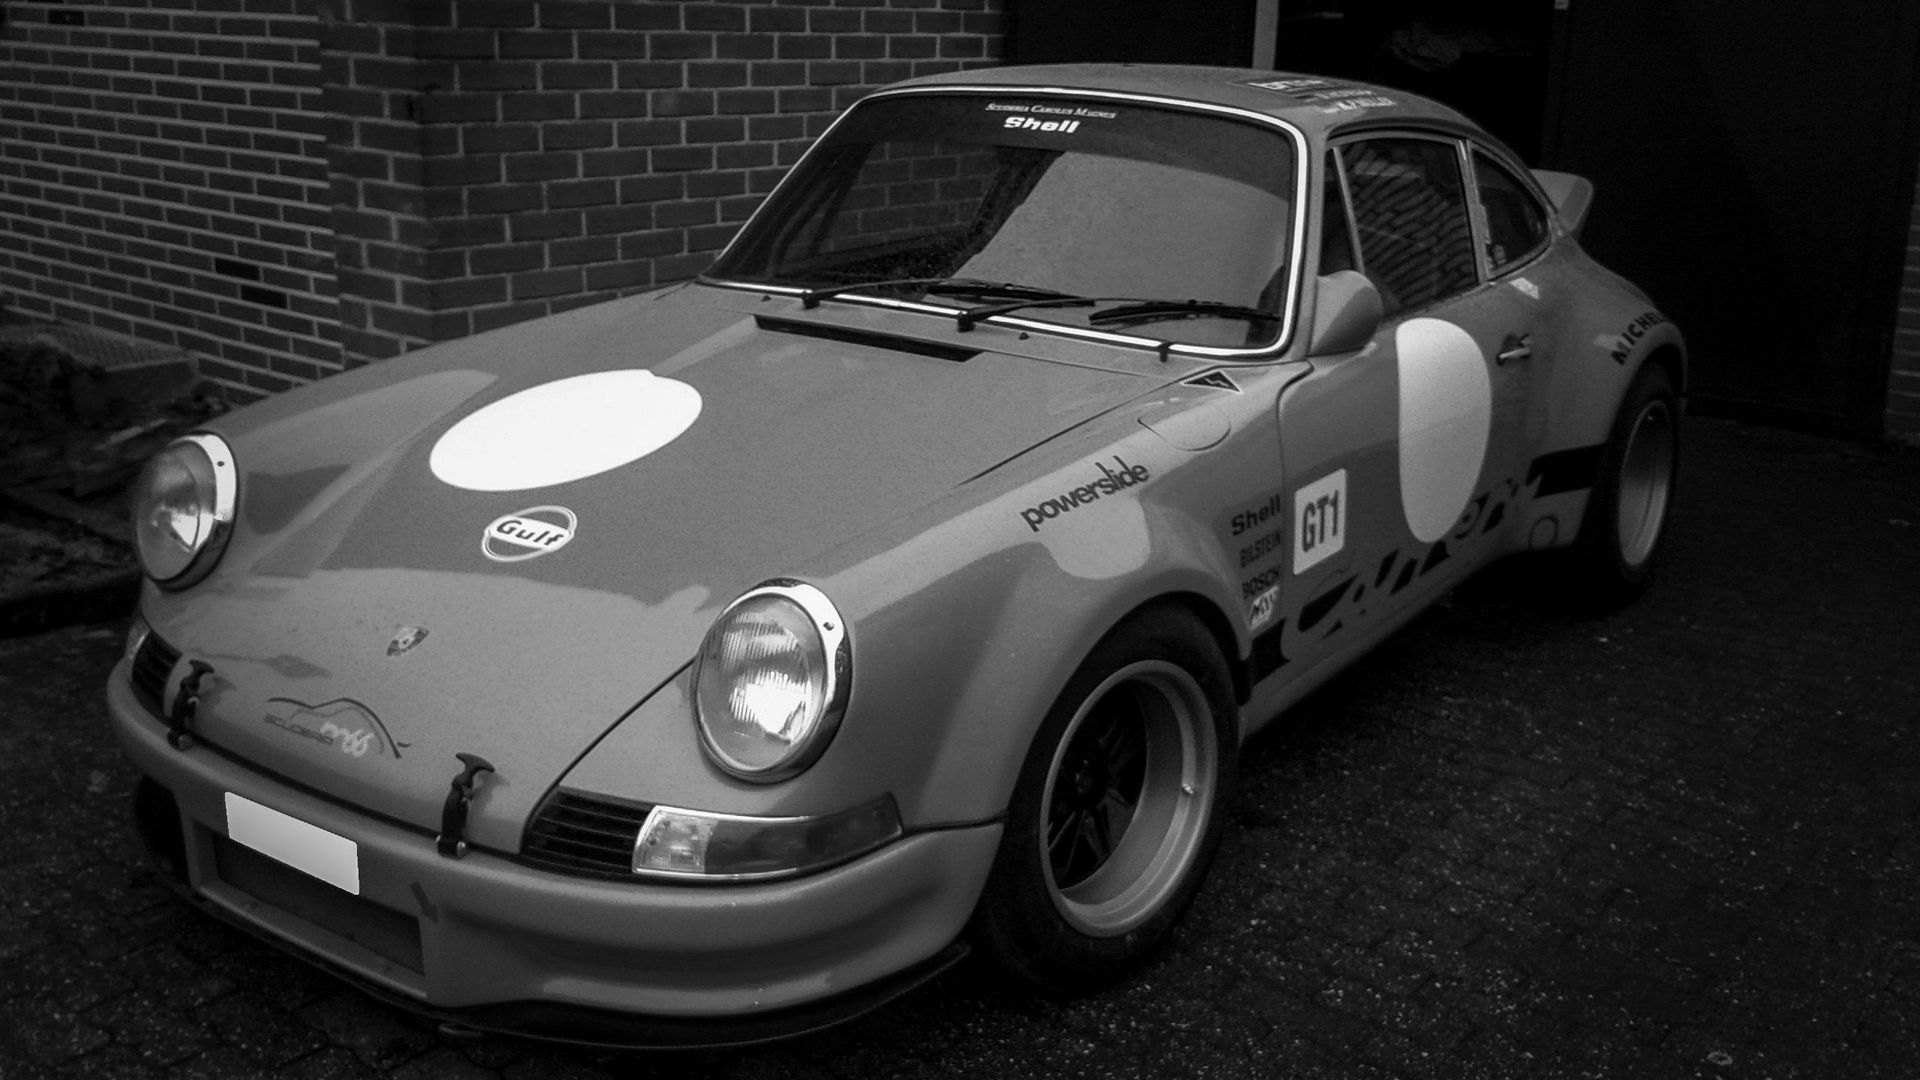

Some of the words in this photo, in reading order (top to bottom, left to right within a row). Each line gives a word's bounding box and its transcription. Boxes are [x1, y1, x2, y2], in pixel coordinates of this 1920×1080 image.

[1003, 116, 1081, 134] Shell
[1020, 455, 1149, 532] powerslide
[496, 519, 564, 546] Gulf
[1231, 494, 1281, 536] Shell
[1302, 490, 1339, 552] GT1
